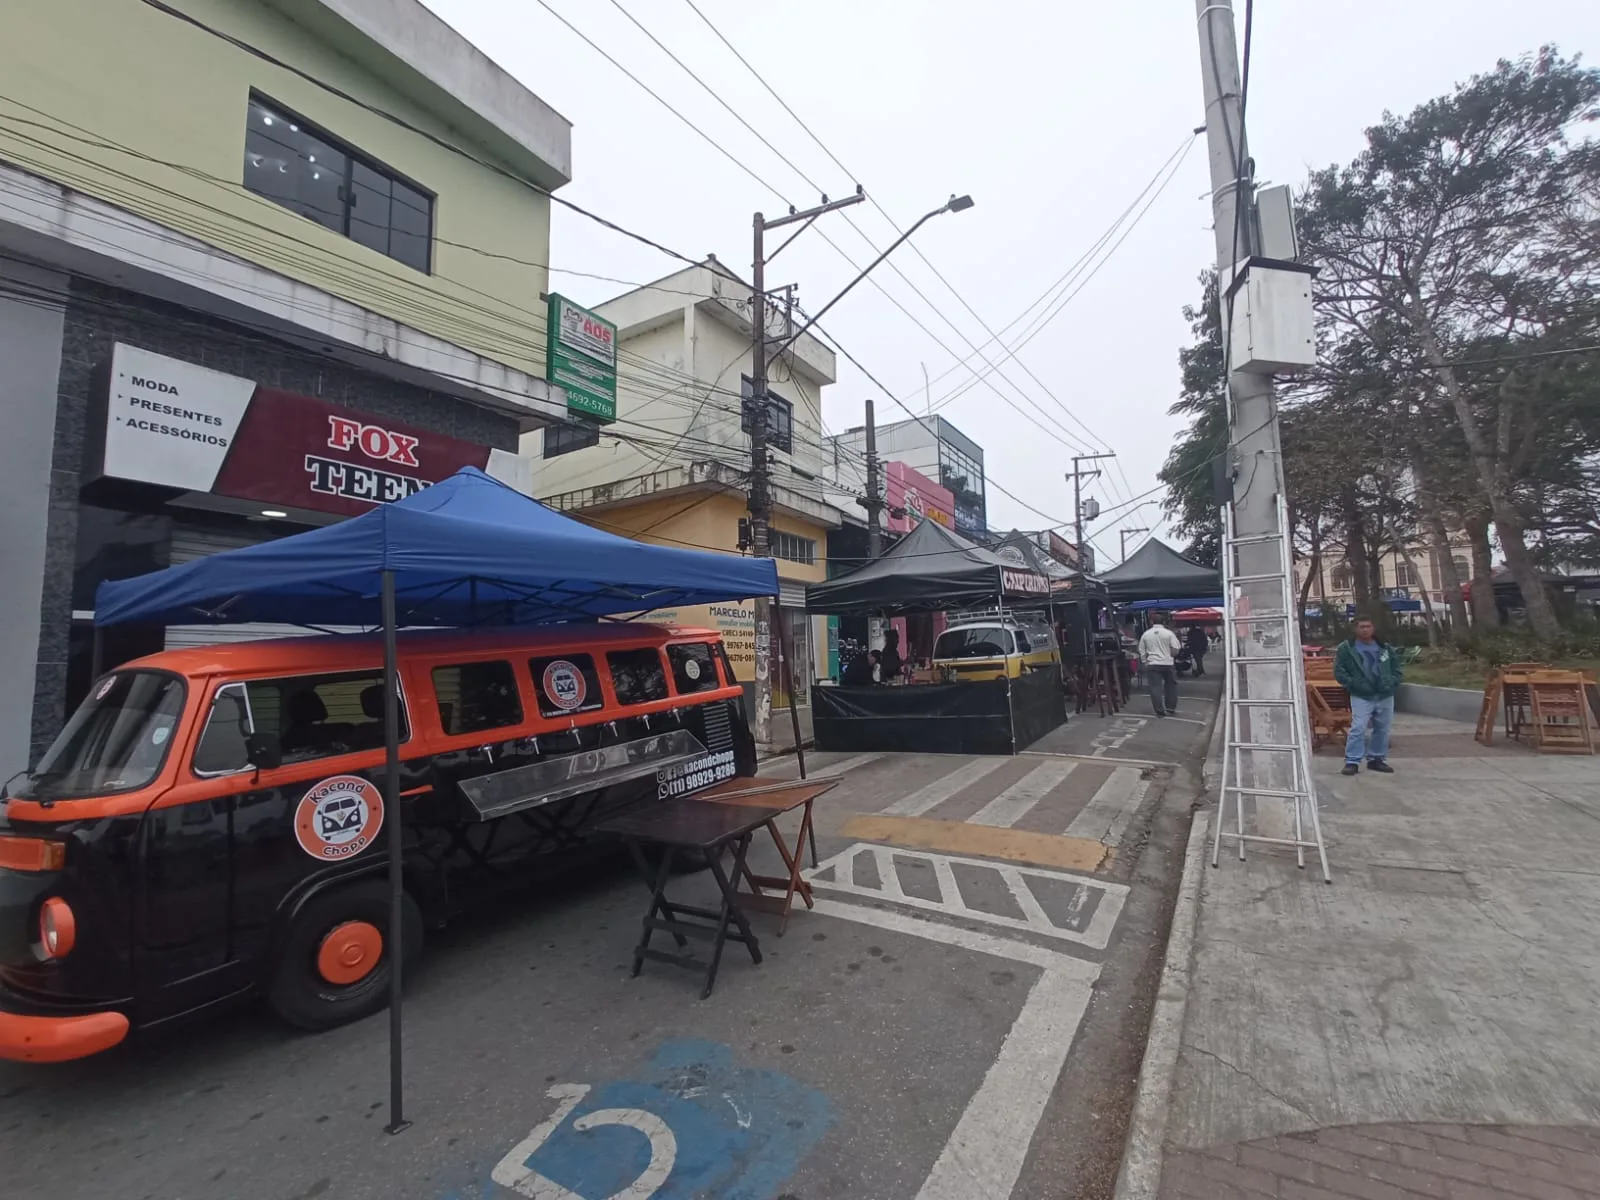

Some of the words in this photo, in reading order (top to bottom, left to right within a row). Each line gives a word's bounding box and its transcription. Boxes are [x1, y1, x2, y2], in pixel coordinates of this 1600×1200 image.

[131, 375, 179, 396] MODA
[129, 397, 223, 427] PRESENTES
[126, 418, 228, 448] ACESSÓRIOS
[328, 415, 419, 467] FOX
[709, 606, 746, 618] MARCELO
[669, 778, 685, 795] (11)
[686, 762, 736, 790] 98929-9286
[309, 781, 366, 804] Kacond
[322, 836, 366, 856] Chopp
